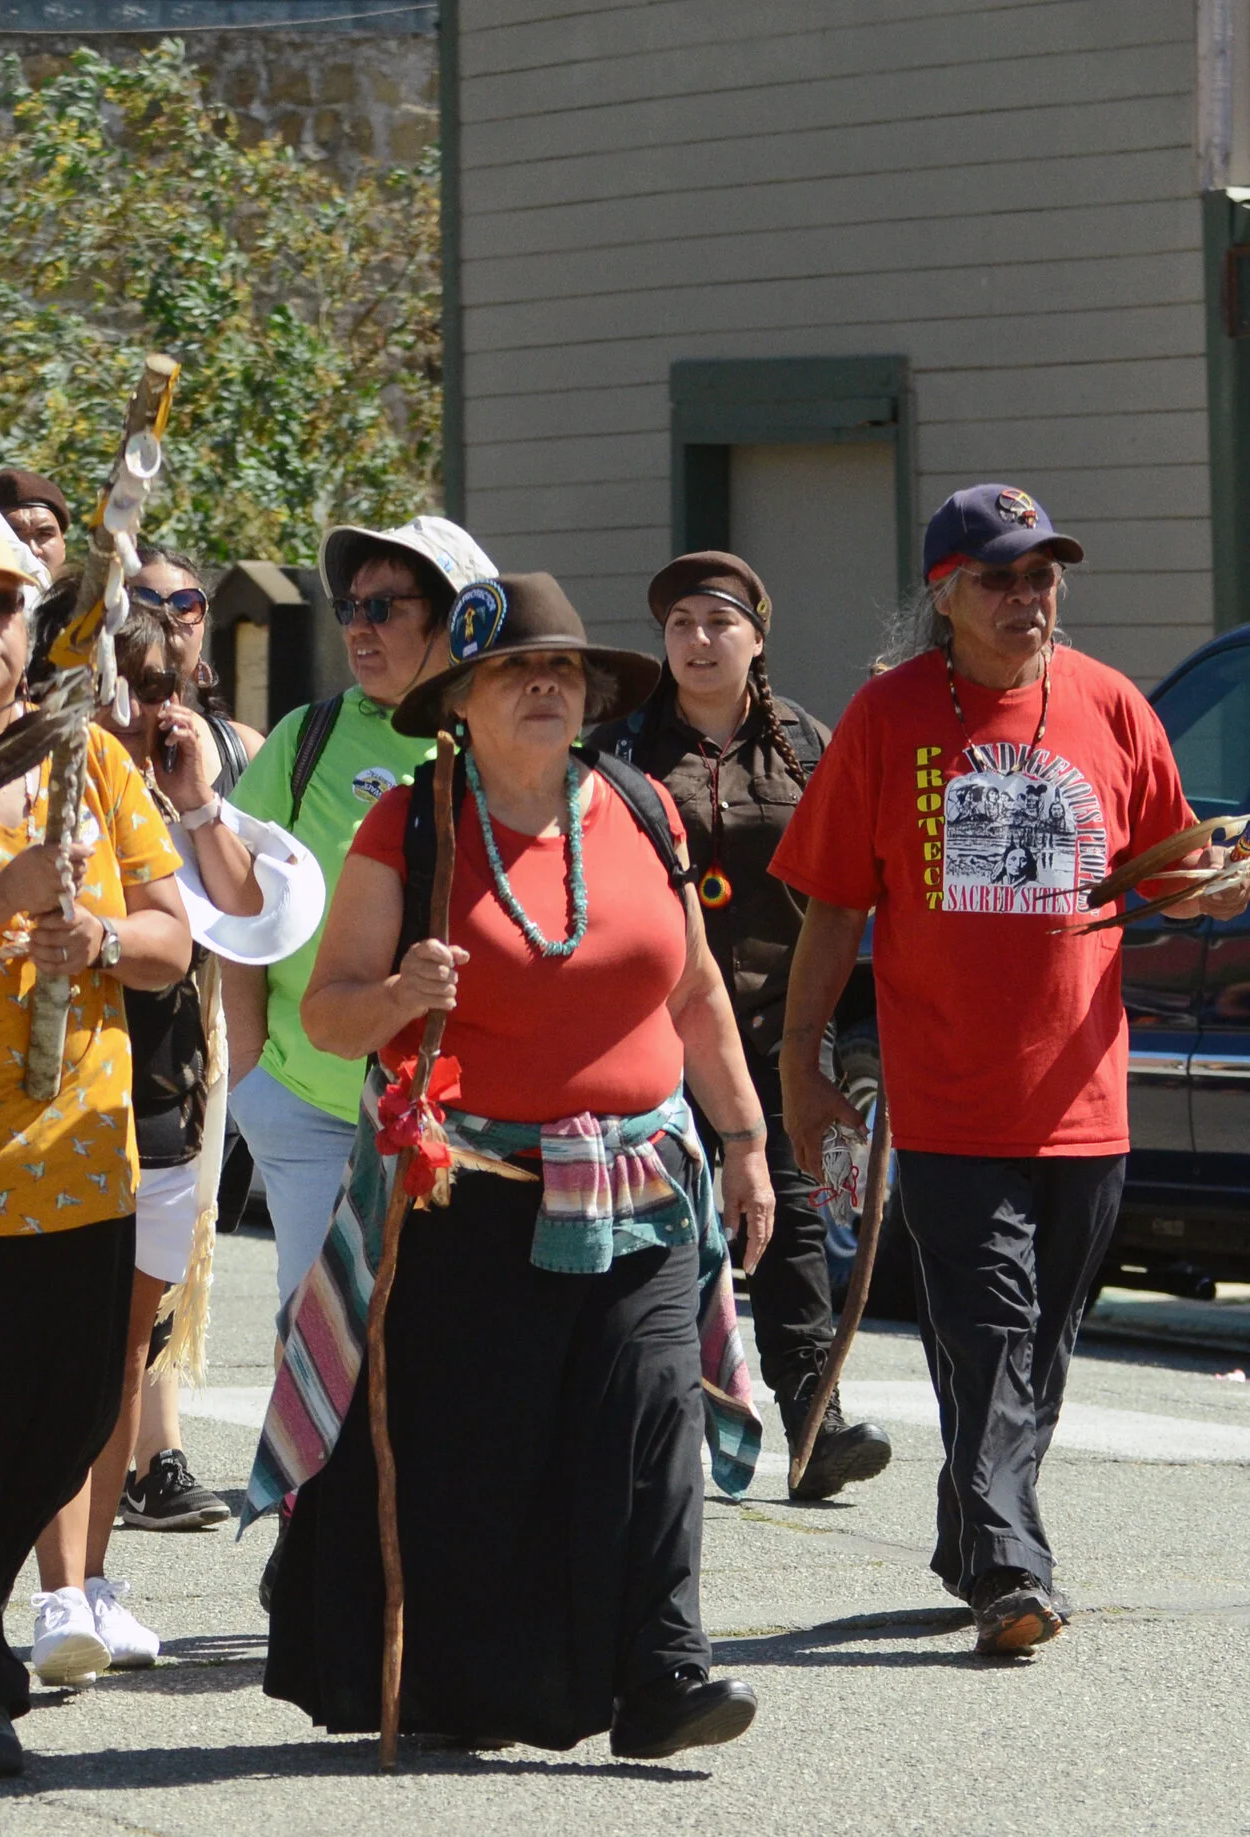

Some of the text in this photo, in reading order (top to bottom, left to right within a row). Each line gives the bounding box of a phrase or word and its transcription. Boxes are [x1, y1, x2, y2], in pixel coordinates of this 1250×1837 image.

[962, 742, 1104, 825] INDIGENOUS
[915, 746, 945, 910] PROTECT
[948, 884, 1072, 915] SACRED SITES
